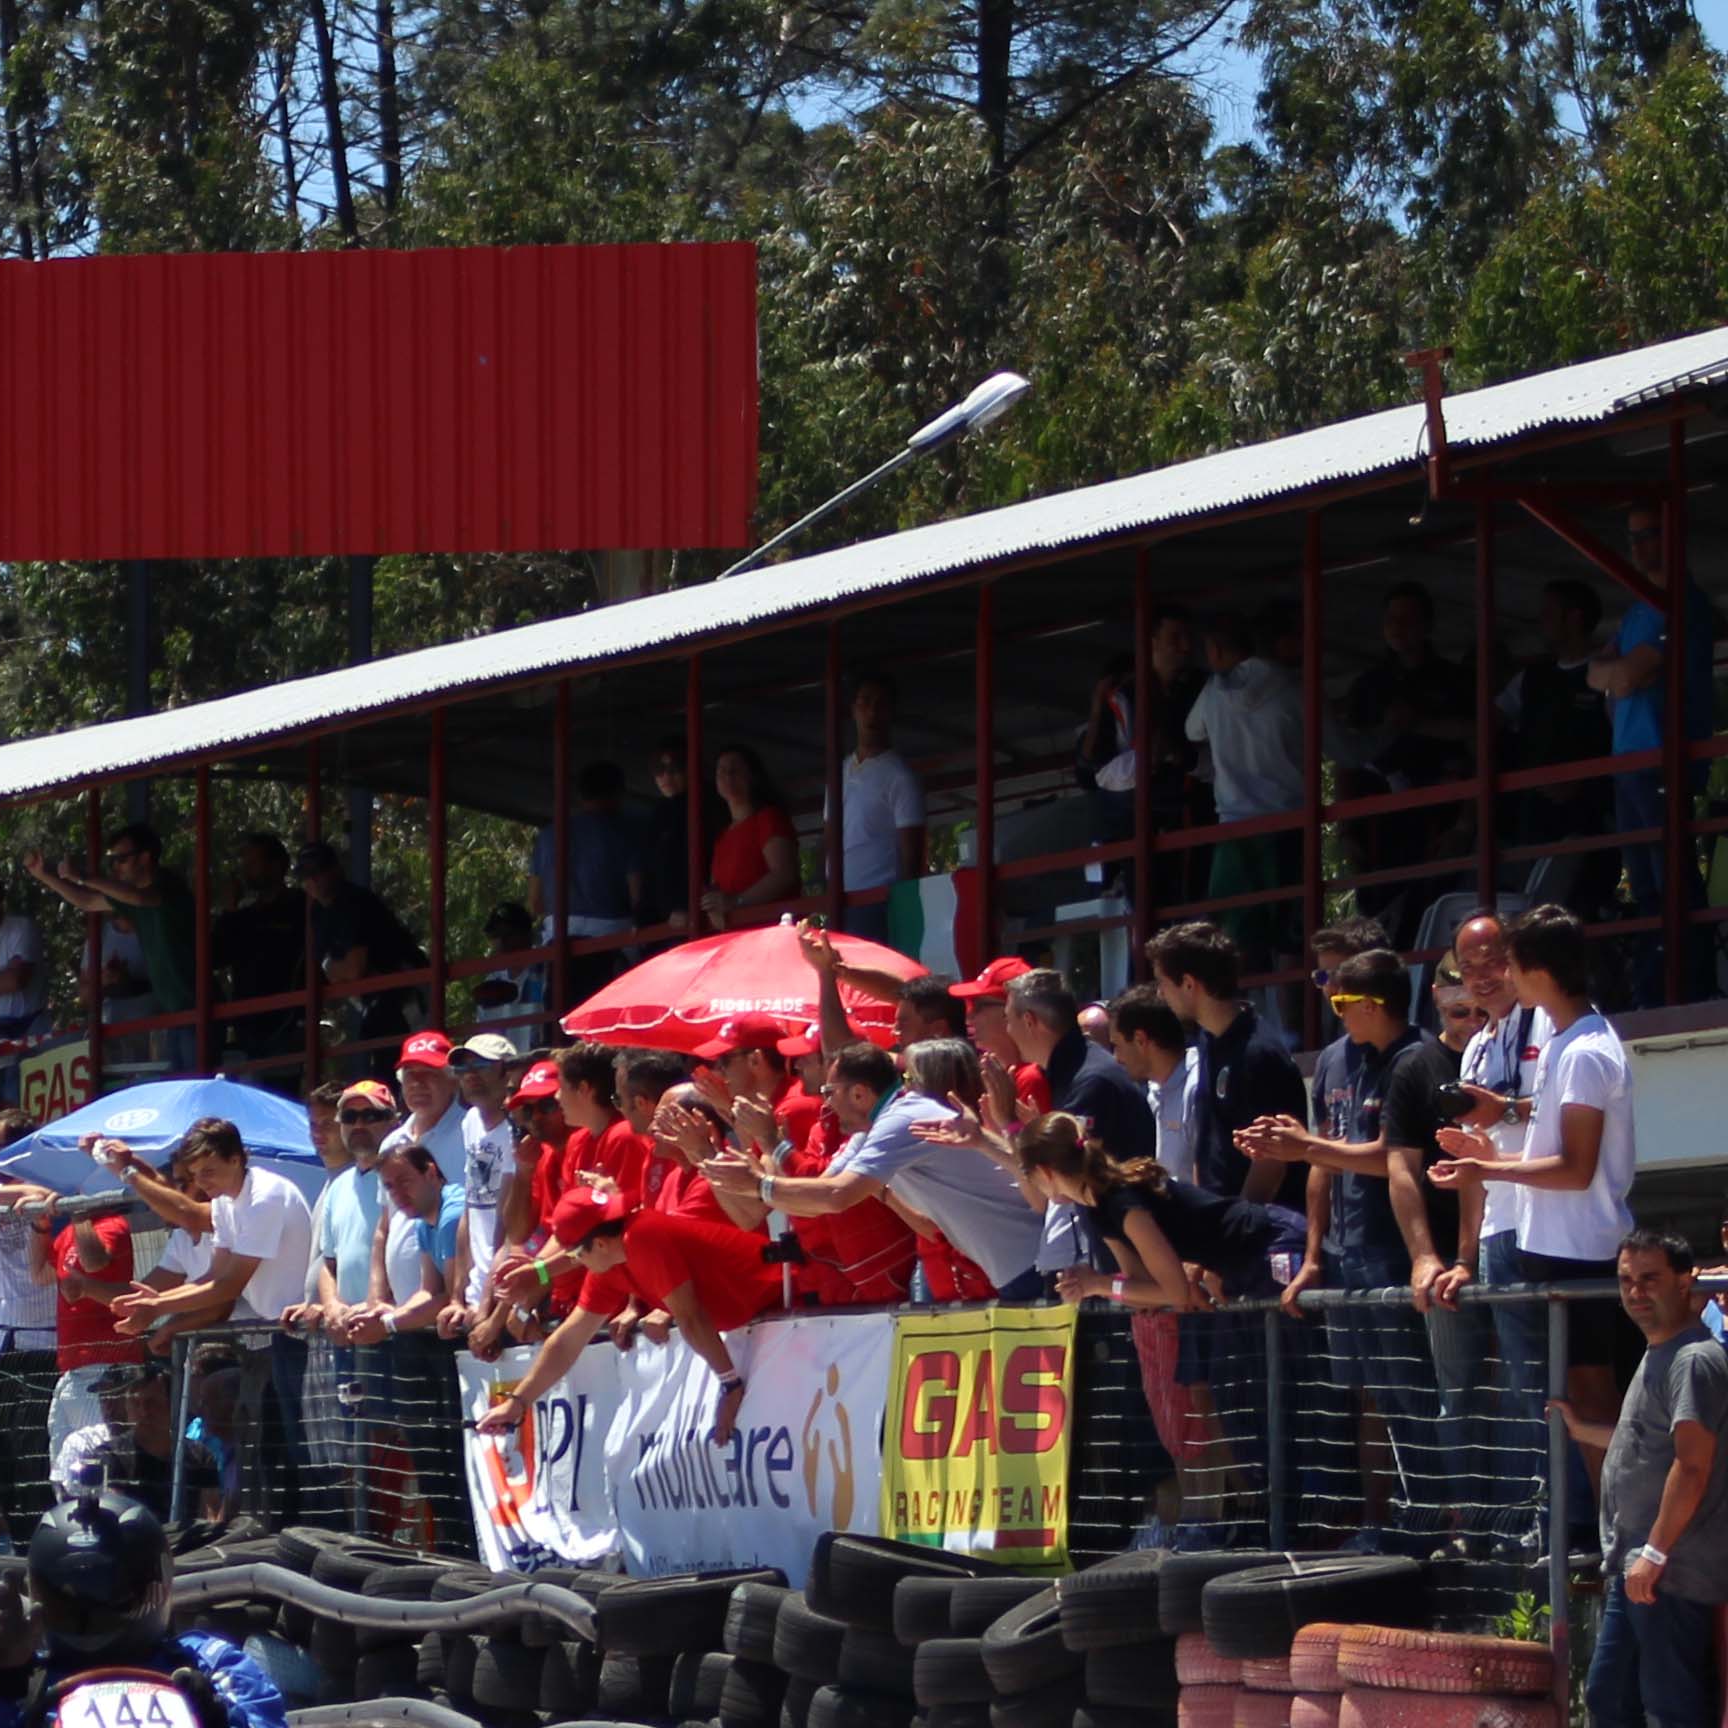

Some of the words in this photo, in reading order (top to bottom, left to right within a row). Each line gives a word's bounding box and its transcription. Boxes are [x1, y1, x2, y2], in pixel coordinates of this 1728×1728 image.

[23, 1055, 92, 1122] GAS
[899, 1344, 1067, 1461] GAS
[895, 1487, 983, 1529] RACING
[991, 1483, 1062, 1526] TEAM
